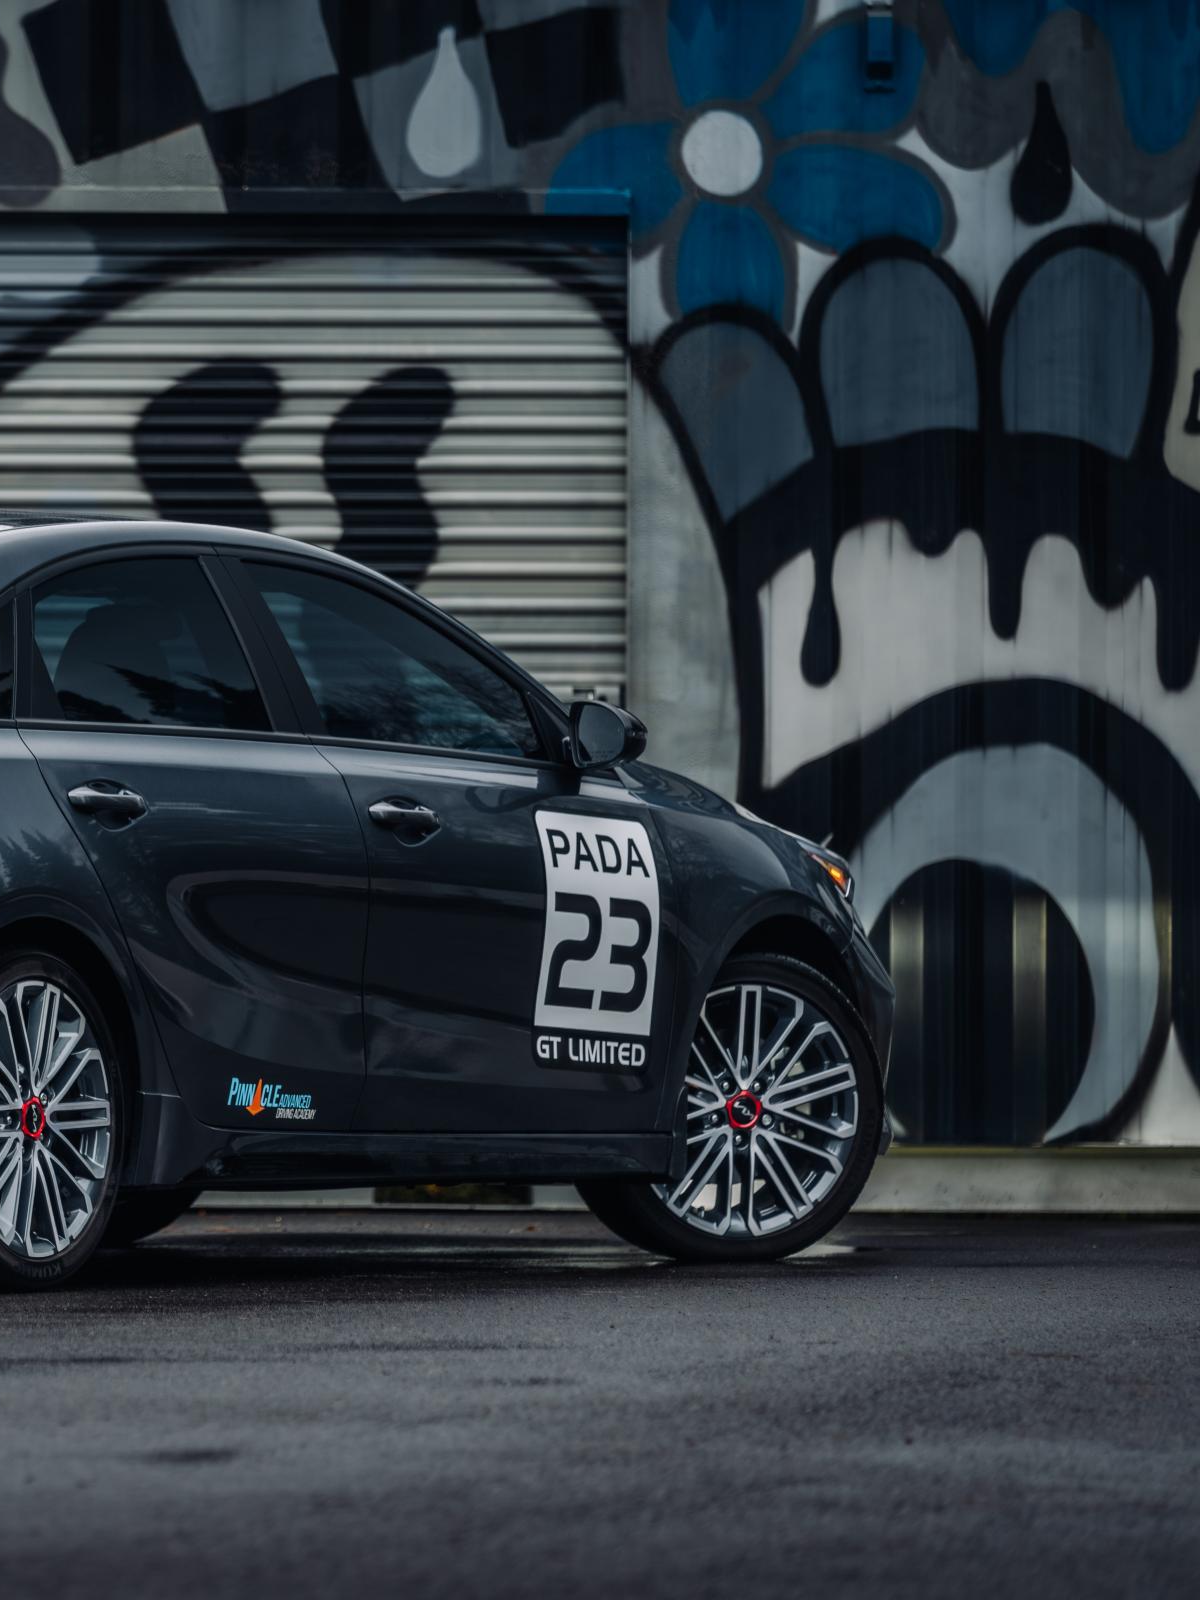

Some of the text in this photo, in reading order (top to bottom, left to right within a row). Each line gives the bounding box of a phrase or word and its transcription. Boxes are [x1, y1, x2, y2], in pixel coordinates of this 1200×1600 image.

[545, 828, 650, 878] PADA
[544, 891, 652, 1014] 23
[536, 1035, 646, 1067] GT LIMITED
